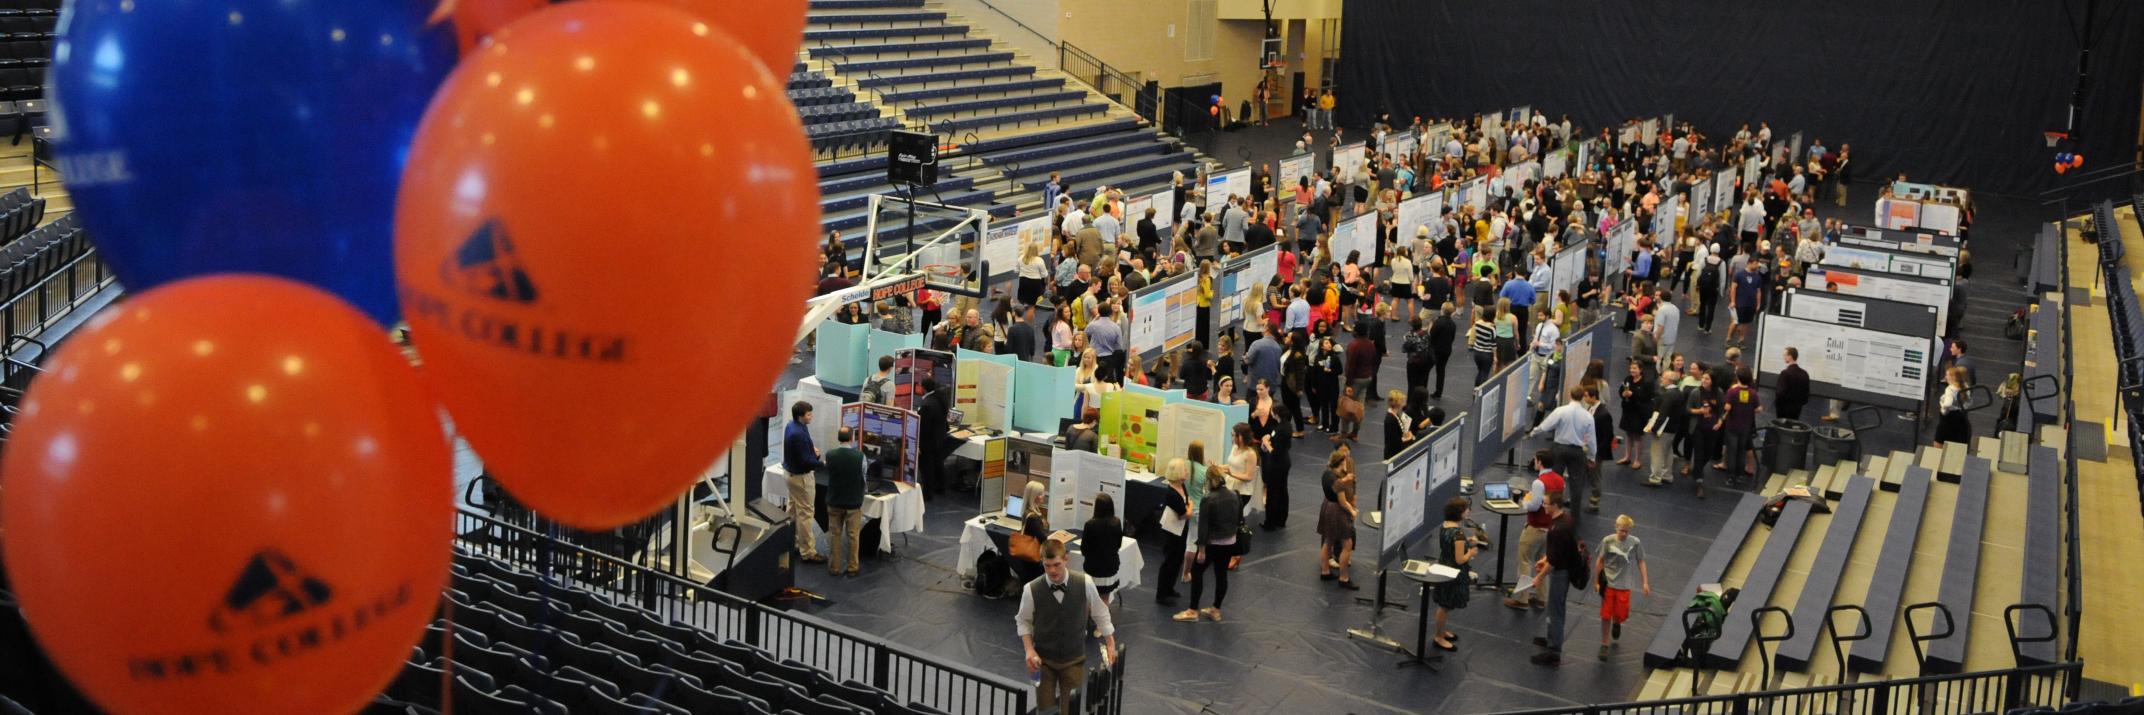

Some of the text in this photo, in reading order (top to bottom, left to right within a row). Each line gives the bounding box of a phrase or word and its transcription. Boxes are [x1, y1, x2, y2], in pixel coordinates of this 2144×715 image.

[842, 289, 870, 303] Schelde
[873, 276, 926, 301] HOPE COLLEGE
[460, 306, 635, 364] COLLEGE
[249, 581, 412, 665] COLLEGE
